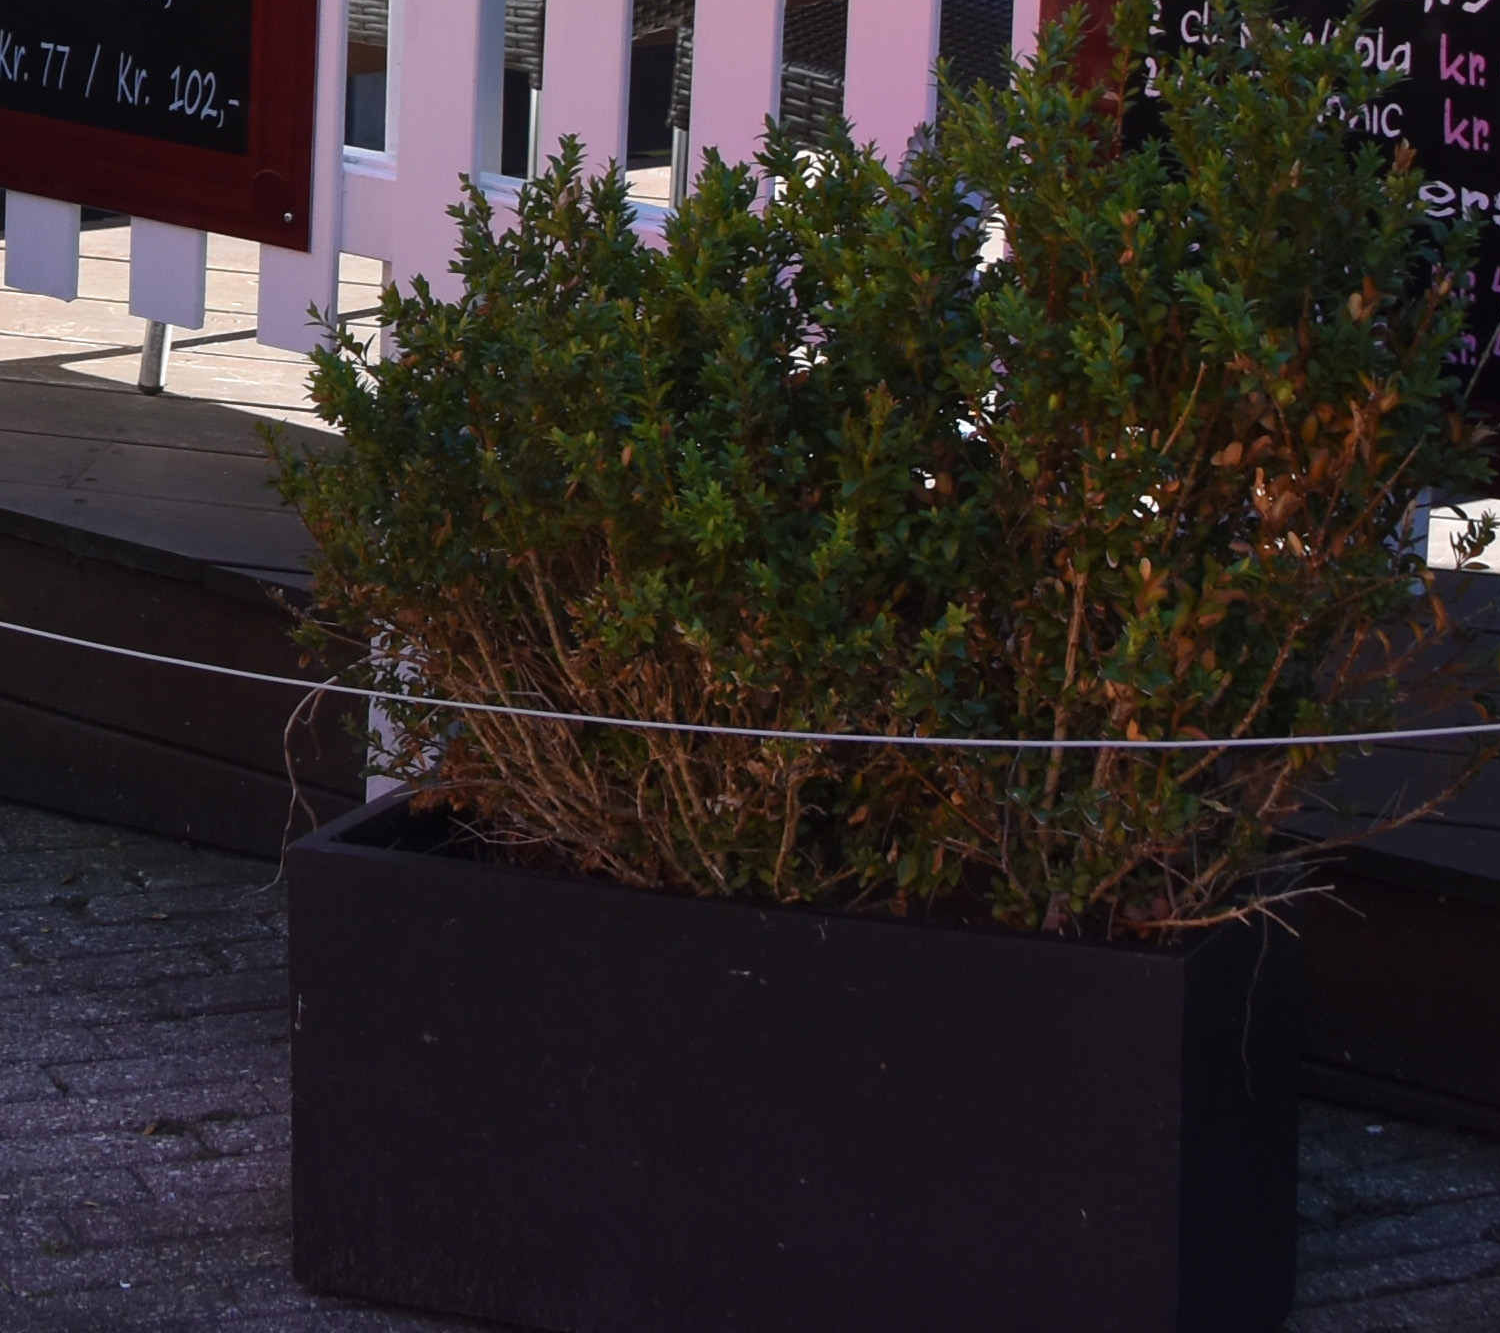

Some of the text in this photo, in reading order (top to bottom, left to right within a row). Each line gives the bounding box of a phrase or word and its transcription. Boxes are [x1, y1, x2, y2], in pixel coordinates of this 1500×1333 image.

[40, 41, 70, 90] 77
[85, 43, 101, 98] /
[117, 51, 150, 106] Kr.
[168, 65, 240, 128] 102,-
[1440, 33, 1486, 87] kr.
[1444, 99, 1490, 152] kr.
